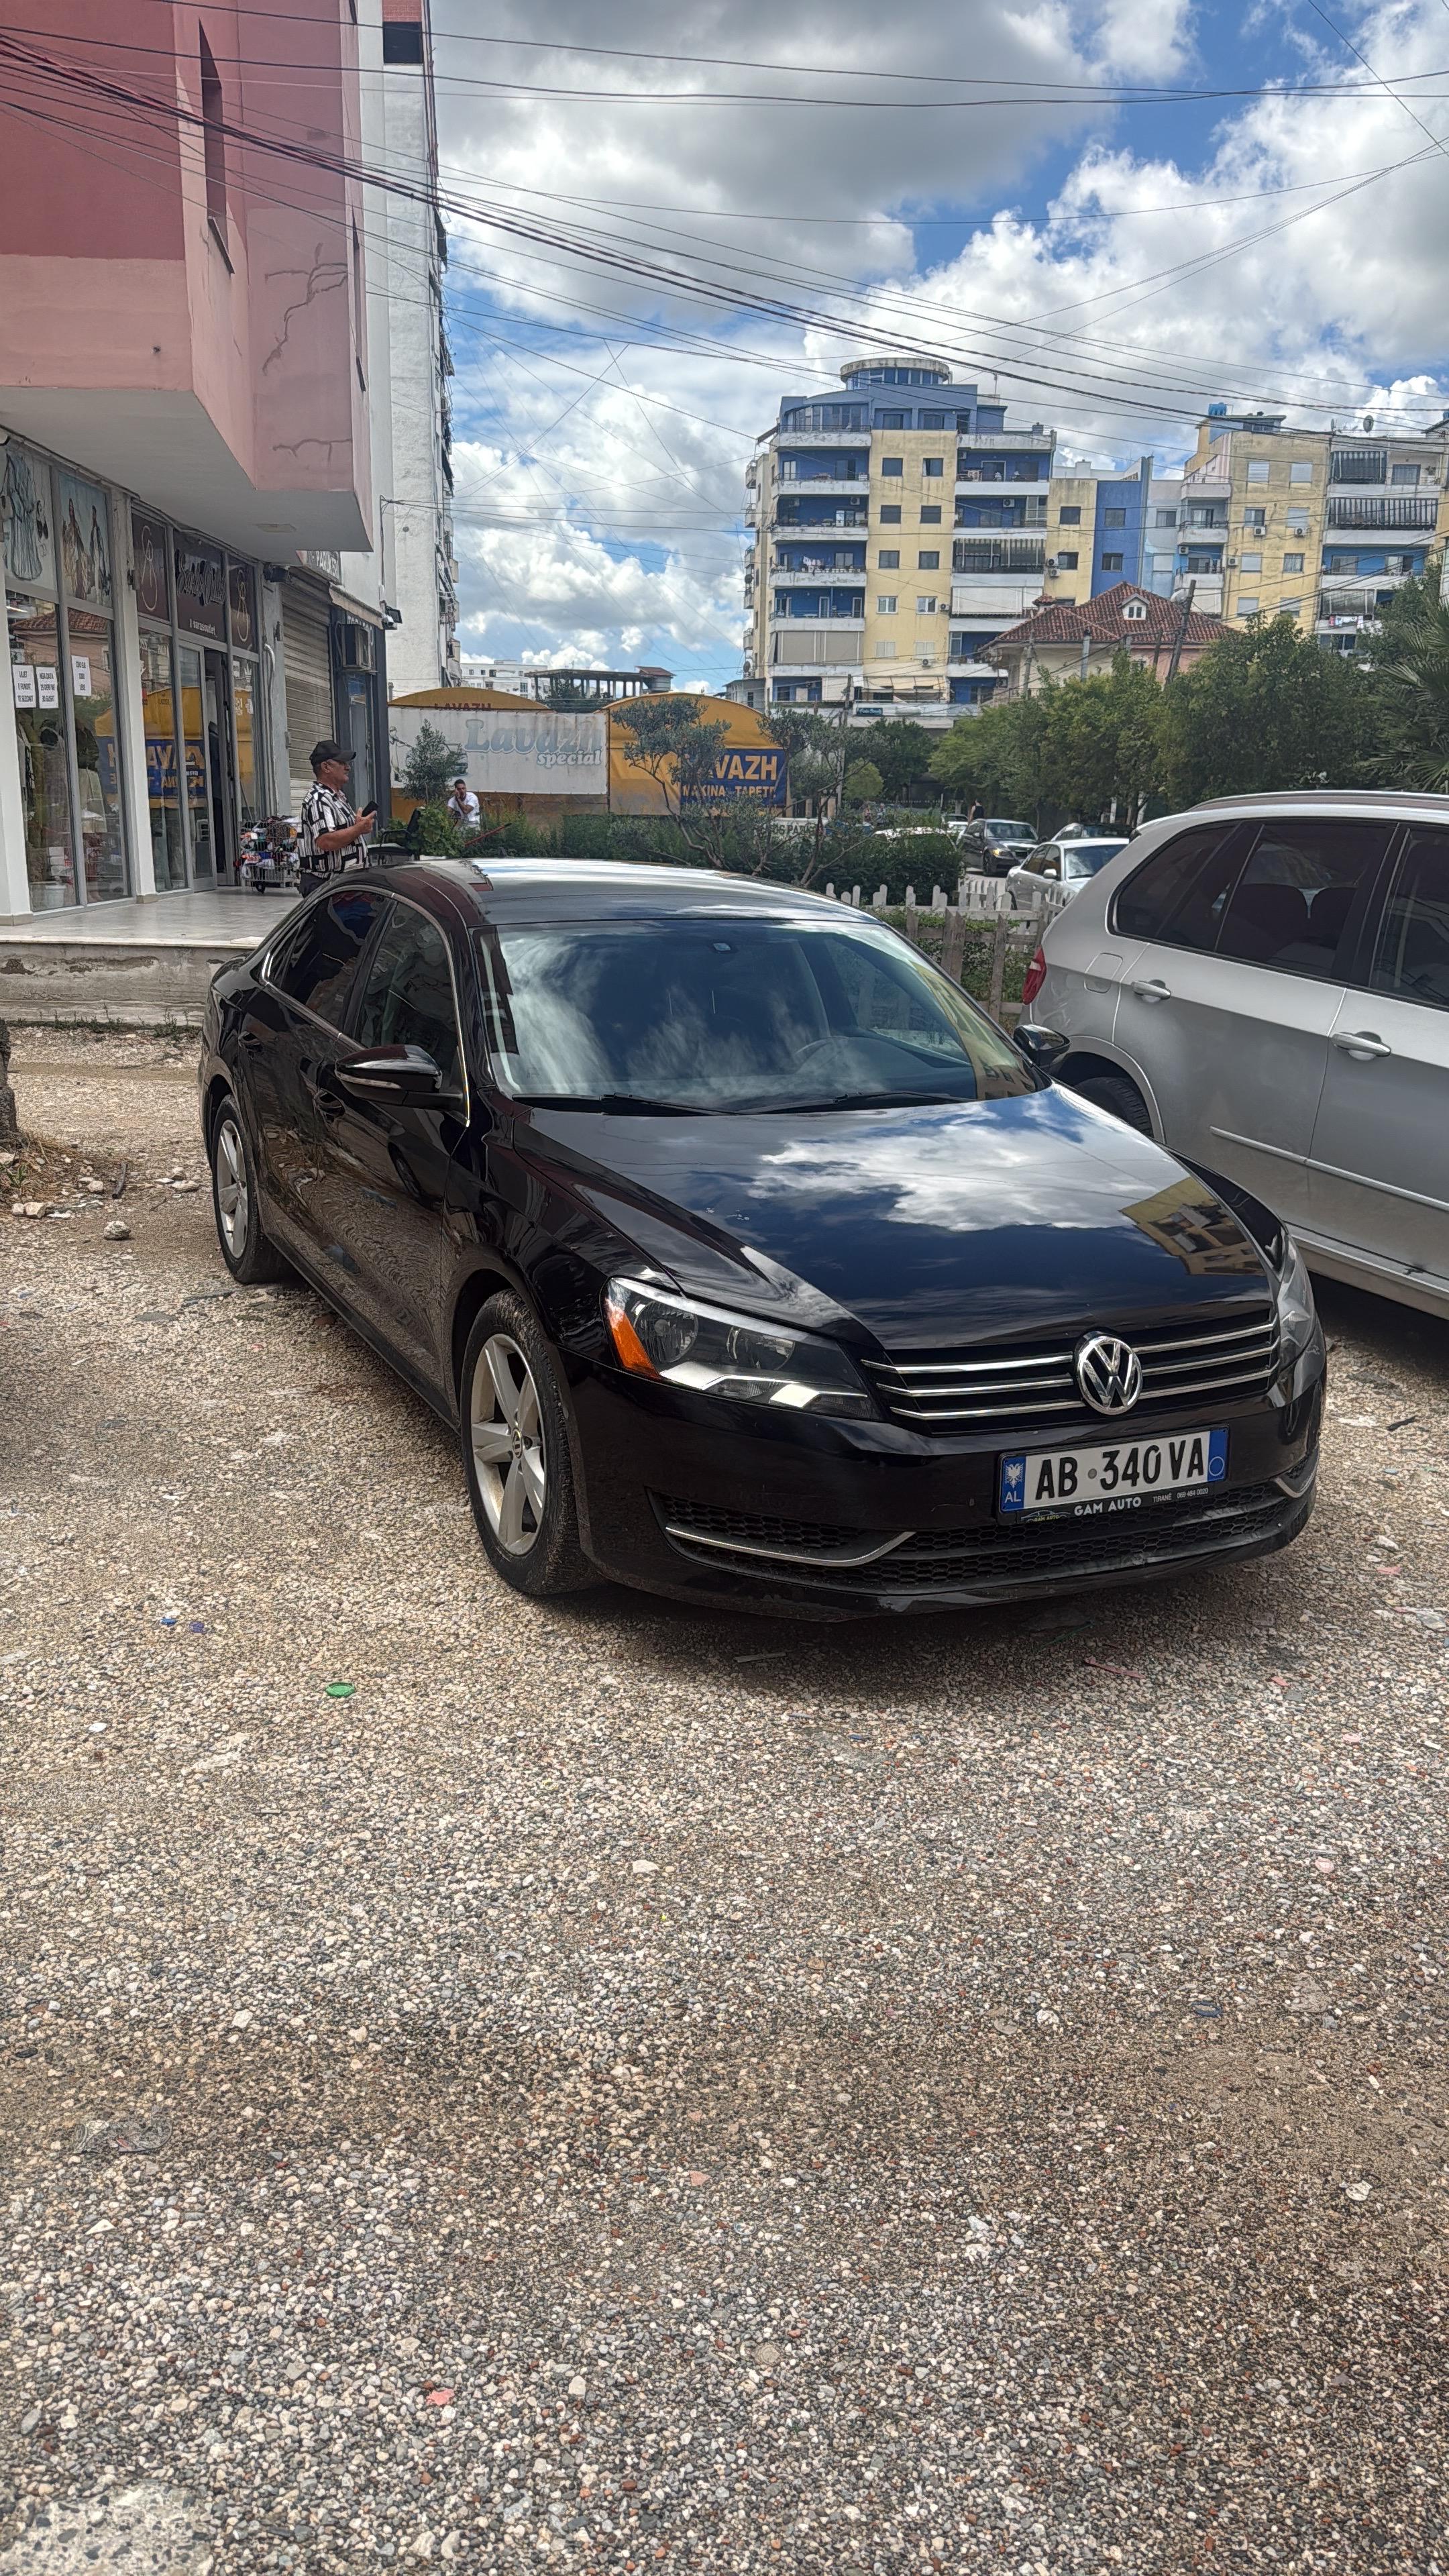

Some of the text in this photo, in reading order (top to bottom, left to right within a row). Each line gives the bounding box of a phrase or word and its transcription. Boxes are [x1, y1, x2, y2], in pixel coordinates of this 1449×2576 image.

[464, 719, 602, 755] Lavazh
[537, 750, 602, 769] special
[708, 755, 777, 780] VAZH
[1035, 1438, 1205, 1501] AB 340 VA
[1004, 1491, 1022, 1503] AL
[1074, 1502, 1104, 1516] GAM
[1108, 1497, 1142, 1512] AUTO
